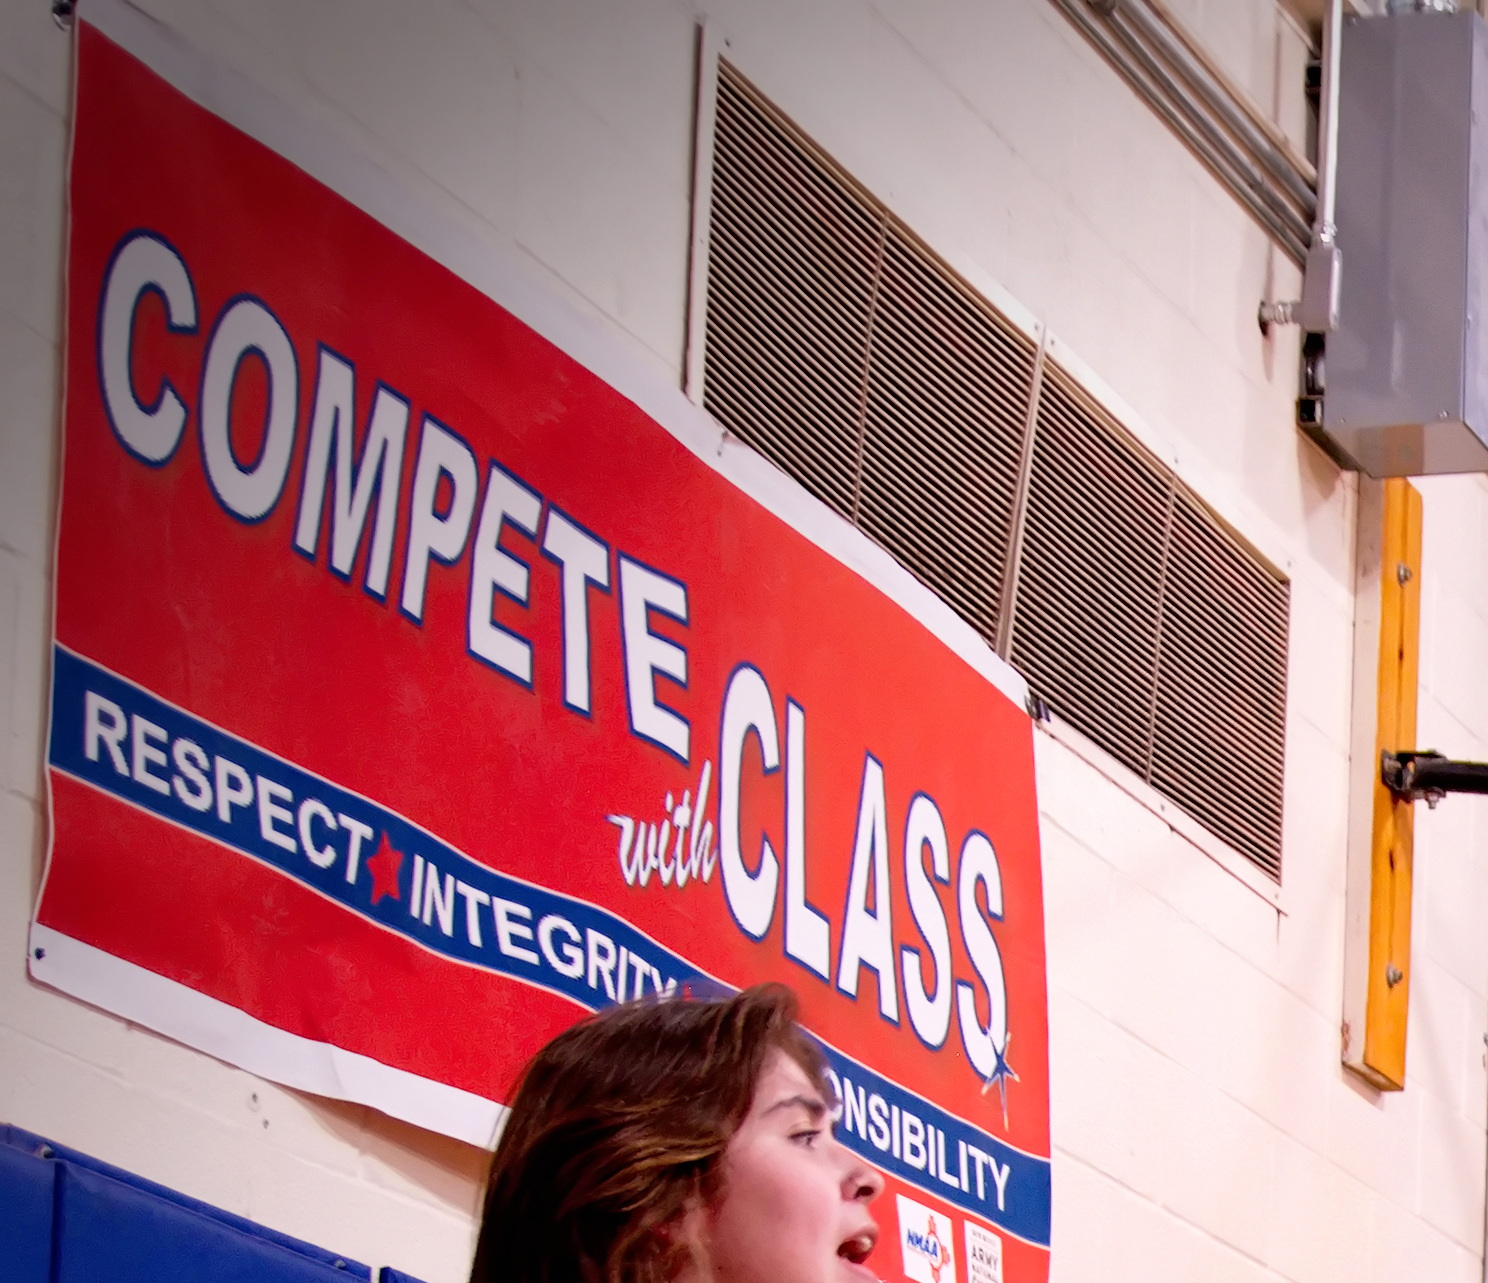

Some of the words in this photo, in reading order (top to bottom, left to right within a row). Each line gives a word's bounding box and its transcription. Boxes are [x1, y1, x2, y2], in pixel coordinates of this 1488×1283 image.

[85, 689, 375, 885] RESPECT
[97, 228, 690, 767] COMPETE
[604, 759, 719, 888] with
[717, 661, 1009, 1083] CLASS
